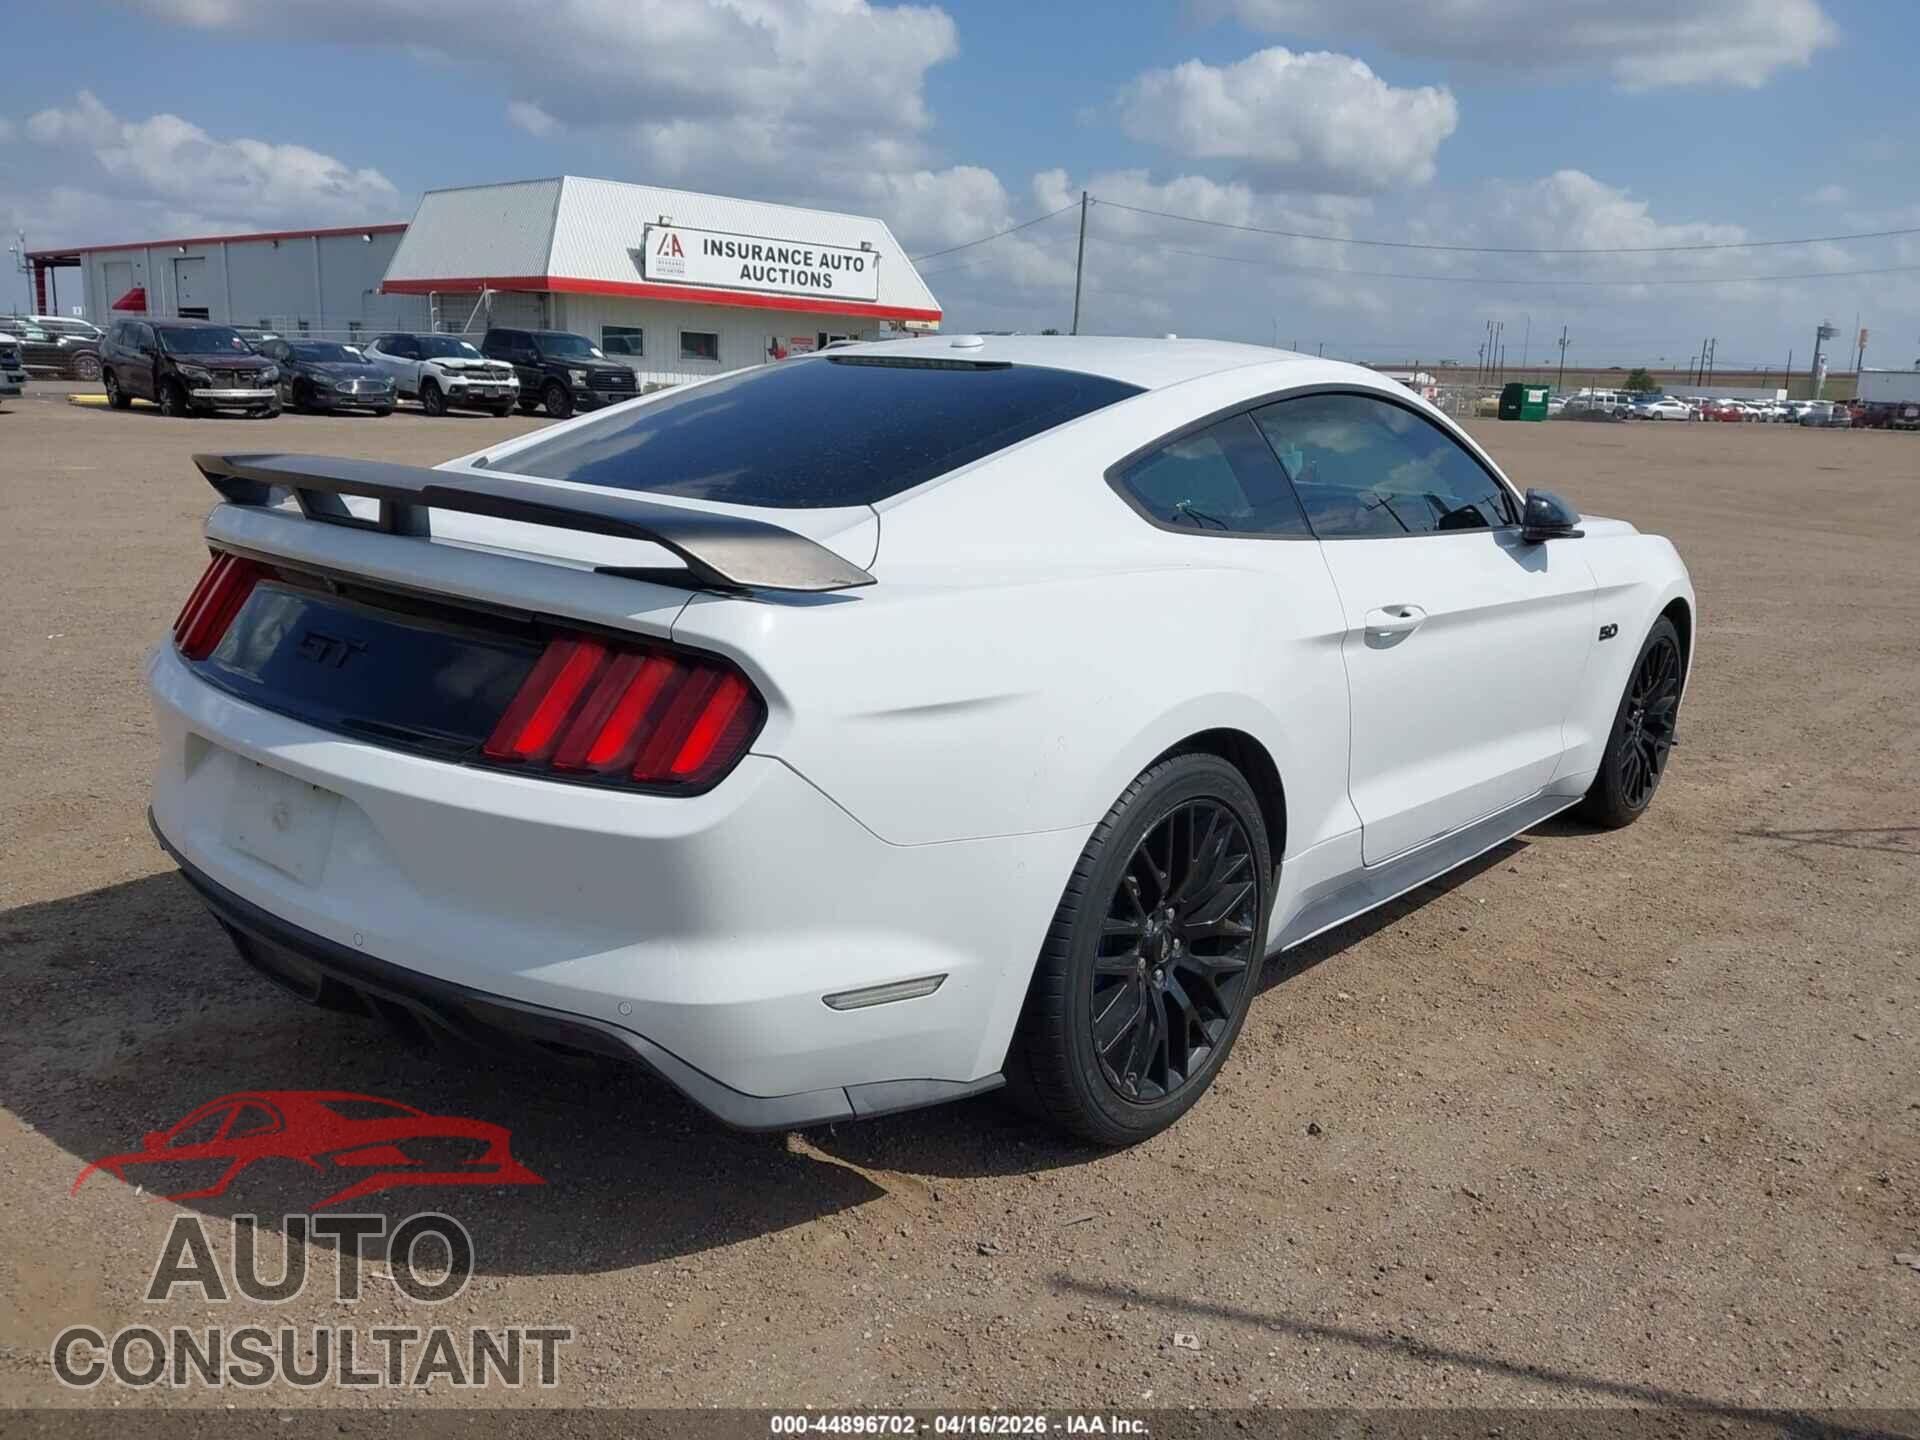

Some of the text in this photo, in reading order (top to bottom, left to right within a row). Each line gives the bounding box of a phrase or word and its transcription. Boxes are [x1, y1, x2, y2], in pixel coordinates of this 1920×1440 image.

[704, 238, 814, 267] INSURANCE
[818, 253, 865, 273] AUTO
[740, 264, 833, 289] AUCTIONS
